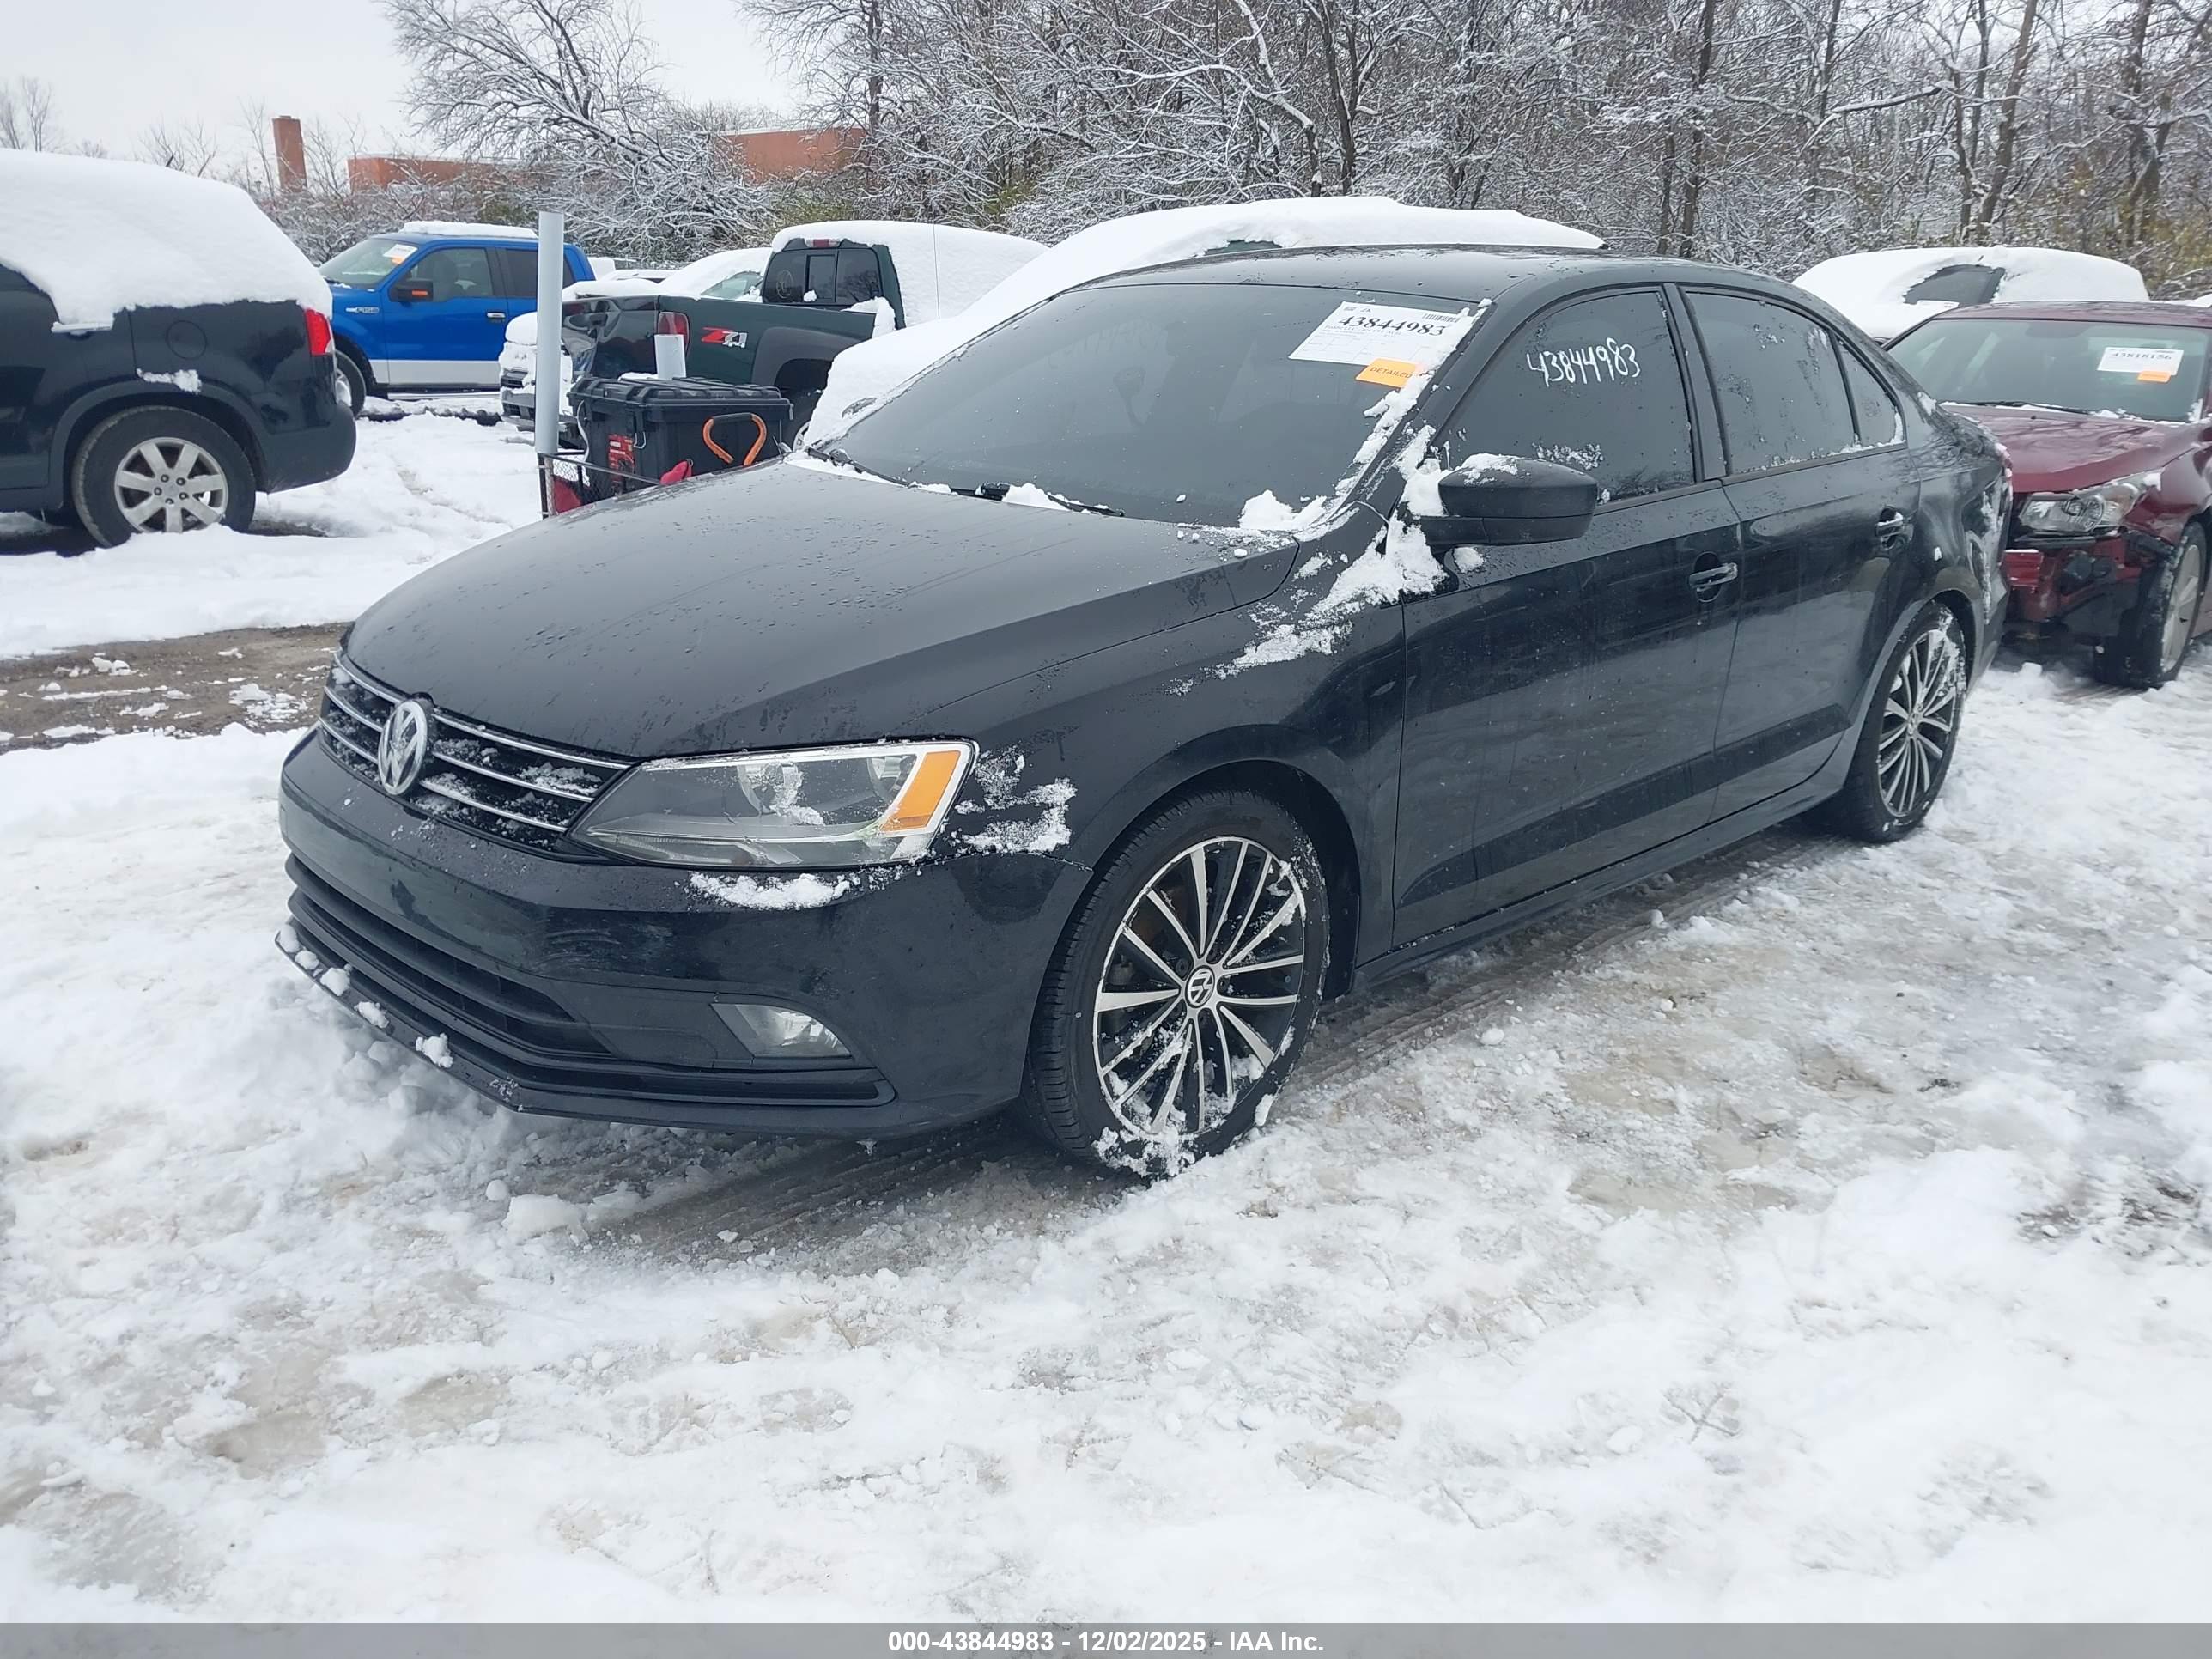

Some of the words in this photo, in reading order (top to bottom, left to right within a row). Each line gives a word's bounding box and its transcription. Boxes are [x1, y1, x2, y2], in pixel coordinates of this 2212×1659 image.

[1338, 315, 1446, 337] 43844983
[1370, 366, 1413, 379] DETAILED
[1526, 337, 1641, 387] 43844983
